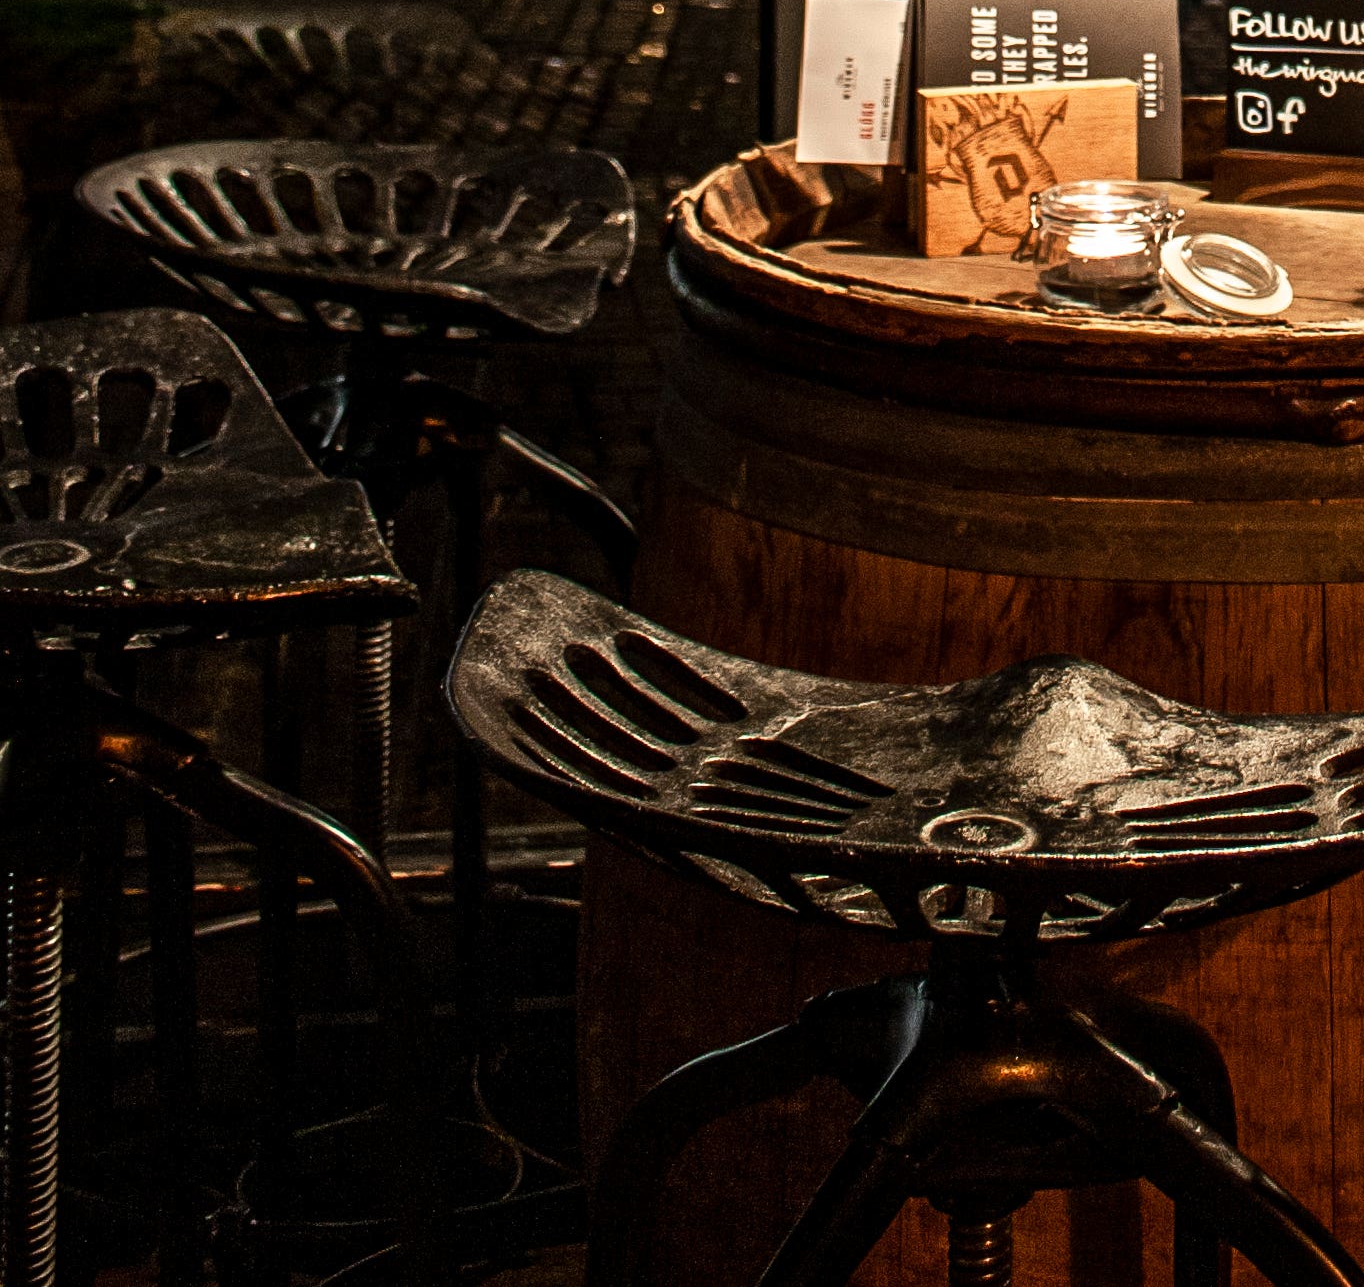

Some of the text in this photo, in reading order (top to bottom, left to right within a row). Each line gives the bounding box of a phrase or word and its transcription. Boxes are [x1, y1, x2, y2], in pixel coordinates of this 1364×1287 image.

[970, 6, 997, 61] SOME
[1002, 34, 1027, 84] THEY
[1143, 53, 1157, 118] WINGMAN
